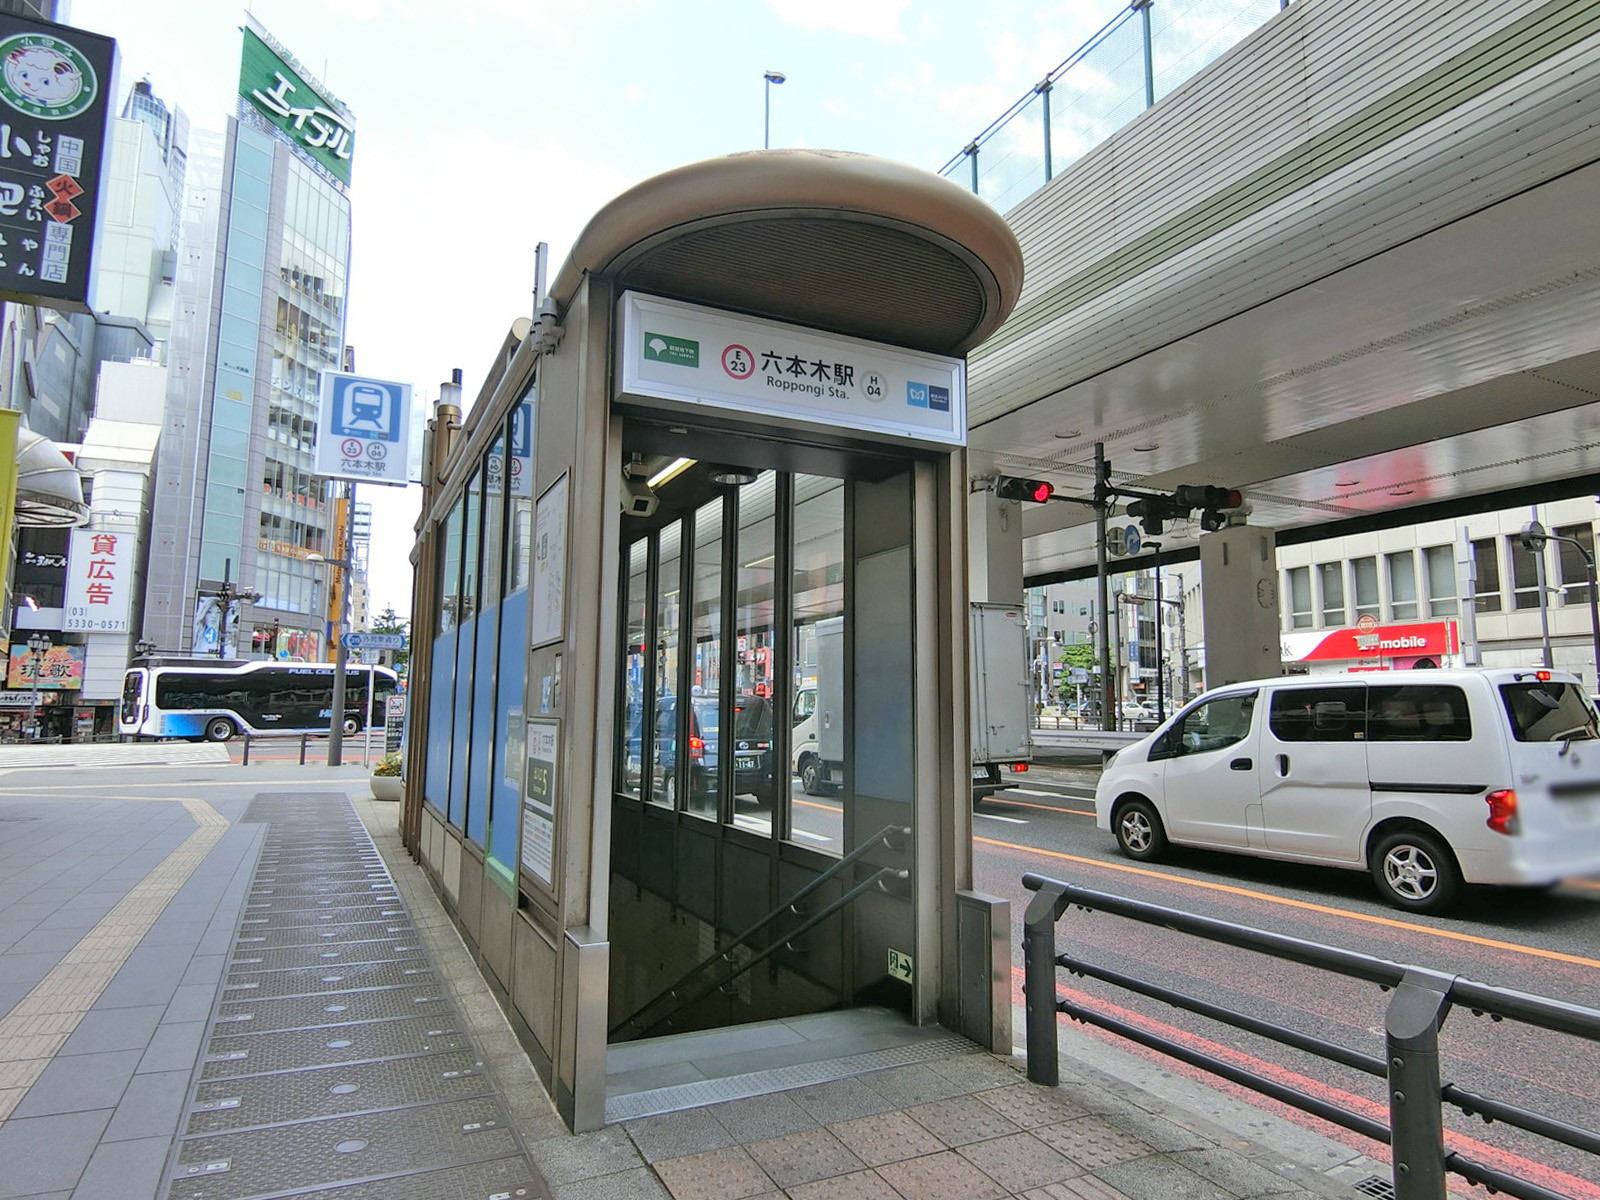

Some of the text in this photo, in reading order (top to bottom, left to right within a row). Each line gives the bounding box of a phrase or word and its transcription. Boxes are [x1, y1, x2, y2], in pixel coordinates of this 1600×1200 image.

[252, 70, 354, 160] エイブル
[735, 351, 742, 360] E
[730, 361, 746, 373] 23
[761, 350, 854, 387] 六本木駅
[870, 376, 878, 385] H
[767, 375, 850, 400] Roppongi Sta.
[867, 386, 881, 397] 04
[341, 458, 386, 472] 六本木駅
[86, 534, 117, 604] 貸広告
[68, 607, 87, 617] (03)
[68, 619, 125, 629] 5330-0571
[1380, 636, 1427, 650] mobile
